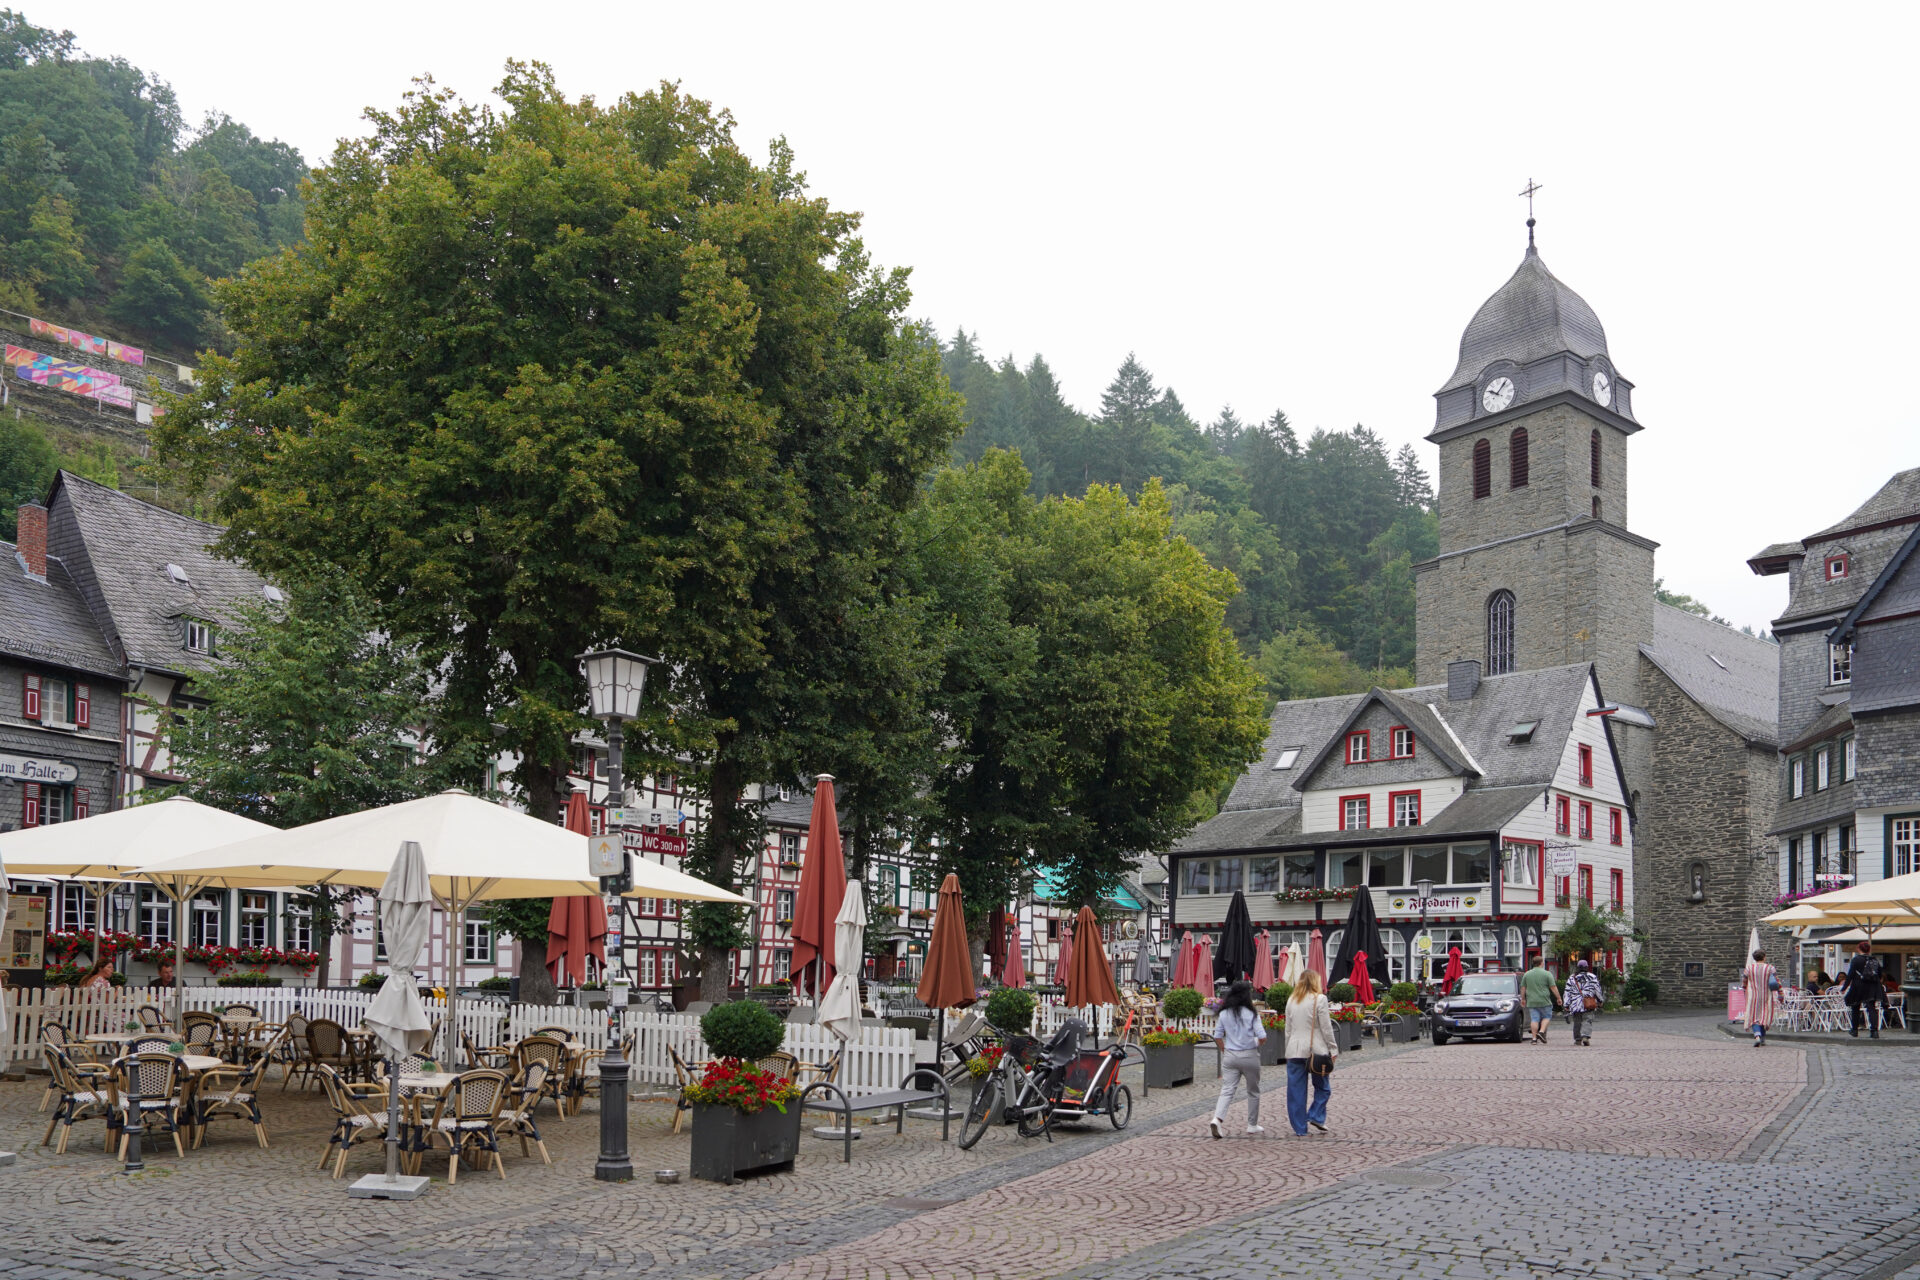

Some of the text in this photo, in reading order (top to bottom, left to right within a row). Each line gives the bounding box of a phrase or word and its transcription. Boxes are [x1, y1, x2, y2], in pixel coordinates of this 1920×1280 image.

[644, 836, 659, 849] WC
[660, 841, 673, 851] 300
[1409, 896, 1460, 910] Flsdorff
